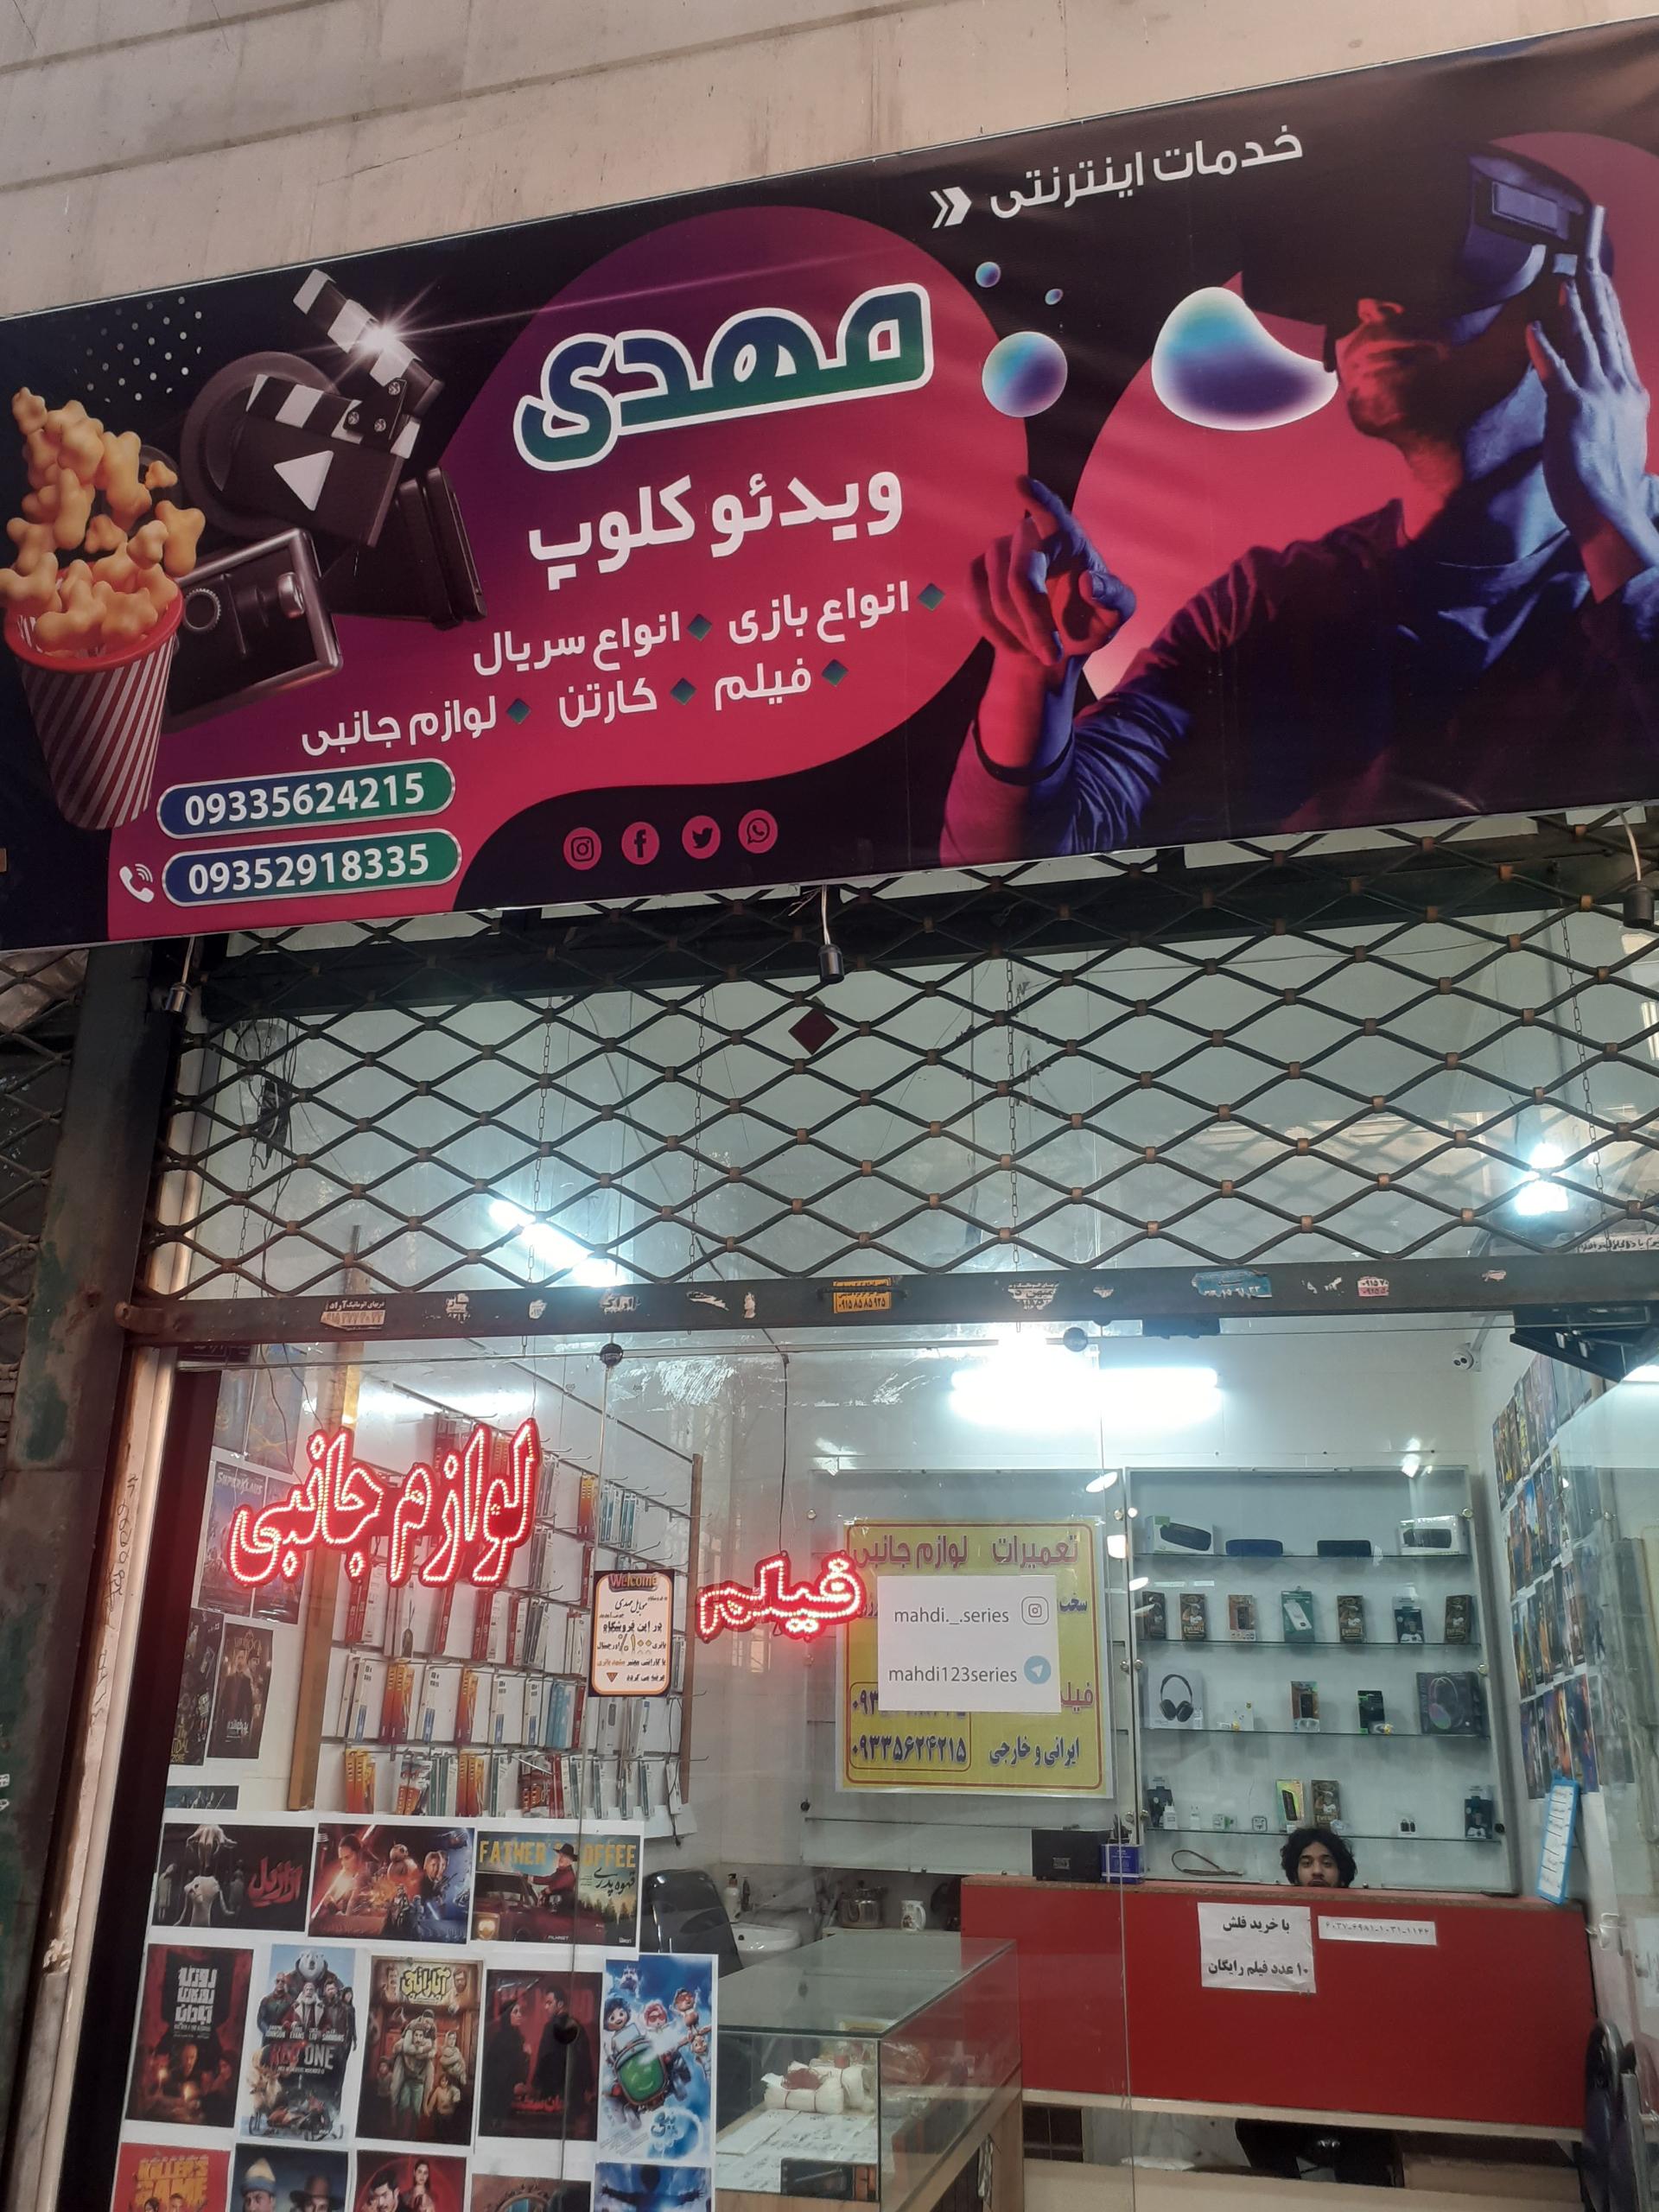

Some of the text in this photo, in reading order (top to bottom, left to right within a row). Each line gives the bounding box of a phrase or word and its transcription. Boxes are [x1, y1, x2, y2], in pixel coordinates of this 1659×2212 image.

[990, 124, 1303, 219] خدمات اینترنتی
[513, 283, 934, 471] مهدی
[529, 471, 903, 591] ویدئو کلوپ
[474, 581, 909, 677] انواع بازی انواع سریال
[302, 658, 812, 757] فیلم کارتن لوازم جانبی
[185, 772, 425, 828] 09335624215
[188, 843, 429, 897] 09352918335
[230, 1428, 385, 1585] جانبی
[391, 1420, 540, 1586] لوازم
[854, 1535, 1079, 1569] تعمیرات لوازم جانبی
[609, 1573, 658, 1588] Welcome
[698, 1555, 864, 1638] فیلم
[893, 1606, 1010, 1625] mahdi._.series
[888, 1666, 1018, 1682] mahdi123series
[1059, 1681, 1094, 1712] فیل
[851, 1733, 968, 1763] ۰۹۳۳۵۶۲۴۲۱۵
[989, 1735, 1080, 1766] ایرانی و خارجی
[479, 1840, 637, 1868] FATHER' OFFEE
[1223, 1916, 1291, 1934] با خرید فلش
[1208, 1958, 1244, 1977] رایگان
[1246, 1961, 1268, 1977] فیلم
[1270, 1963, 1294, 1976] عدد
[304, 2042, 335, 2070] ONE
